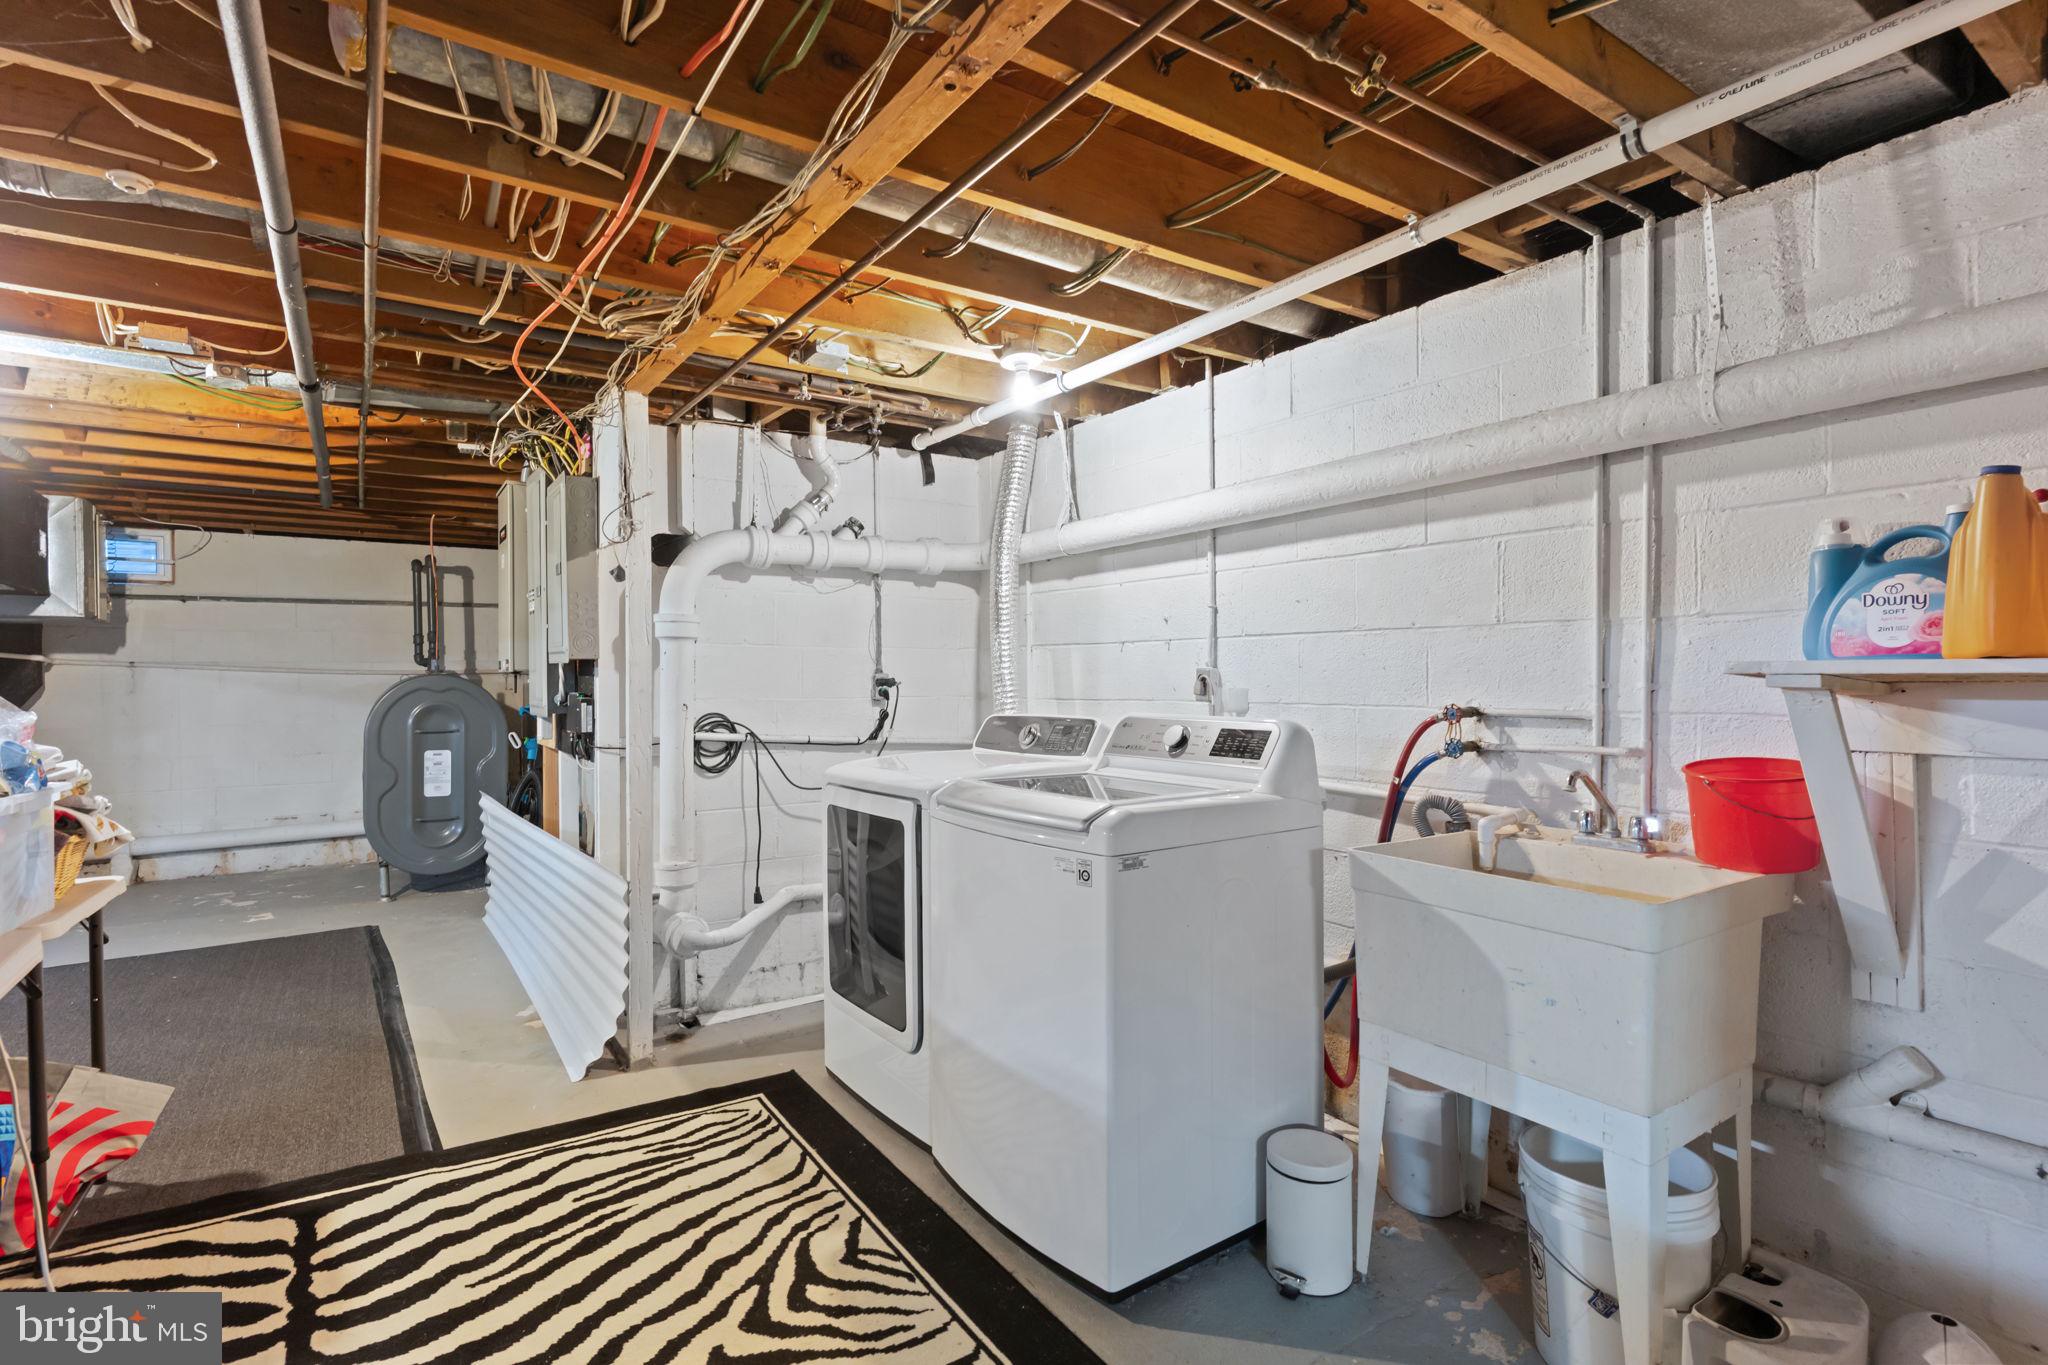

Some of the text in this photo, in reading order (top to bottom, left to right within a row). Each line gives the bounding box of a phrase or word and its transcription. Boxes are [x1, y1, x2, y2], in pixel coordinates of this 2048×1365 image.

[1813, 31, 1867, 60] CELLULAR
[1869, 20, 1899, 37] CORE
[1492, 187, 1506, 198] FOR
[1553, 160, 1569, 171] AND
[1569, 151, 1589, 164] VENT
[1589, 142, 1610, 156] ONLY
[1863, 594, 1927, 610] Downy
